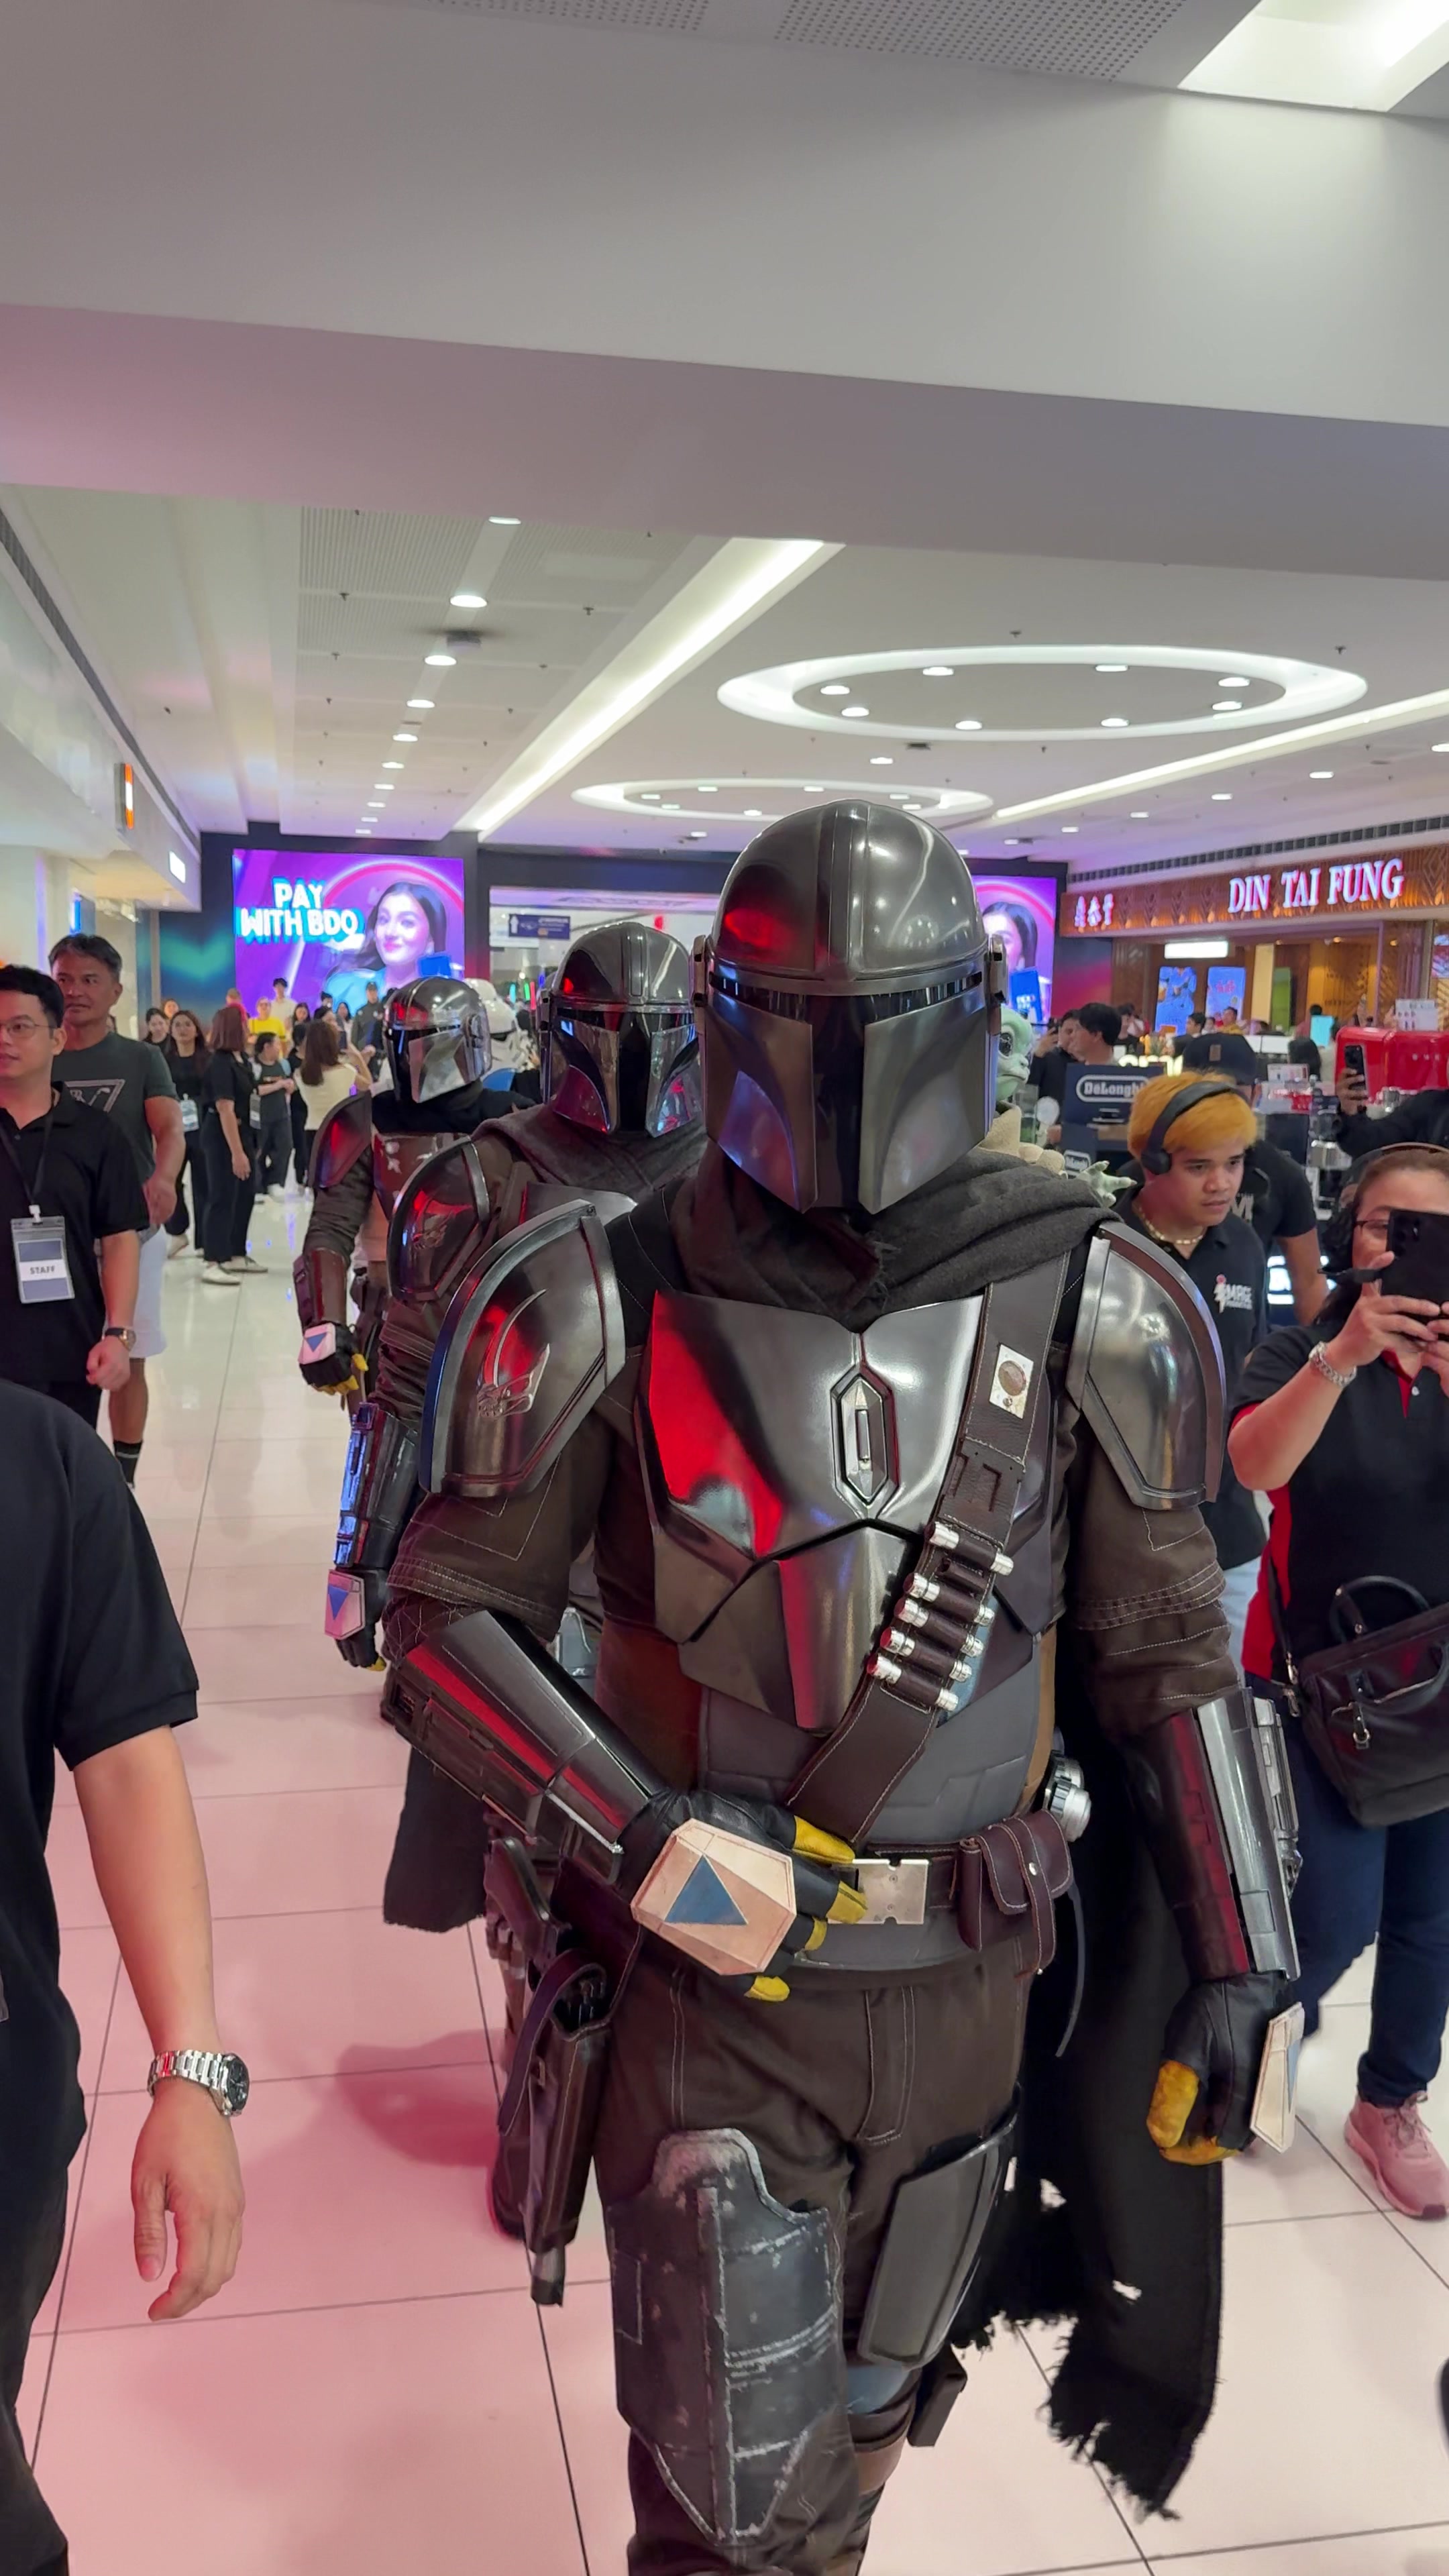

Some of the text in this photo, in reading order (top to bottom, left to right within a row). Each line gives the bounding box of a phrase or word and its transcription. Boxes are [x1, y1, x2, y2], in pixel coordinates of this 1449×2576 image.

[272, 883, 323, 909] PAY
[1228, 858, 1405, 913] DIN TAI FUNG
[240, 908, 359, 936] WITH BDO
[30, 1265, 55, 1275] STAFF
